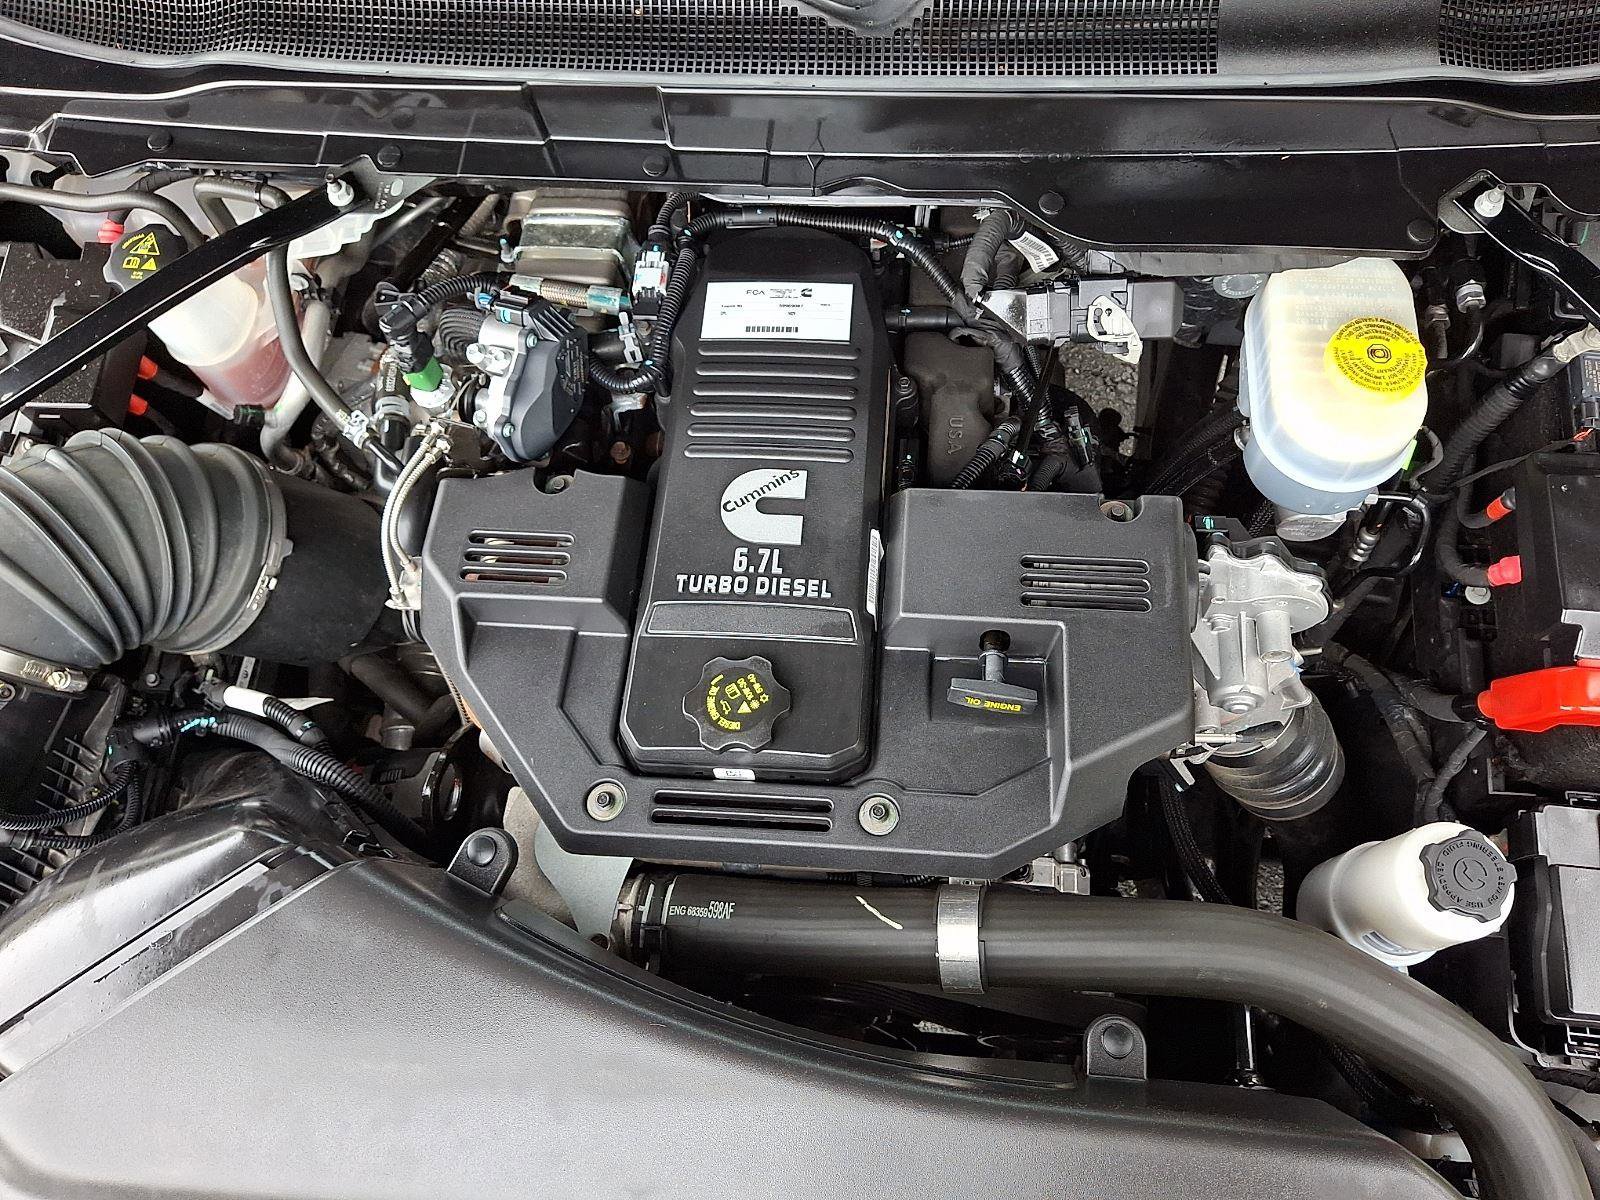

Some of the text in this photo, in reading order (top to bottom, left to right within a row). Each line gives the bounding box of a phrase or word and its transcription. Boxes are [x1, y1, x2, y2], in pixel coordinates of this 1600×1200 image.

[947, 417, 964, 455] USA
[722, 469, 801, 513] Cummins
[733, 547, 783, 574] 6.7L
[676, 574, 832, 599] TURBO DIESEL
[965, 696, 1022, 712] ENGINE OIL
[1442, 842, 1464, 857] FLUID
[669, 905, 687, 916] ENG
